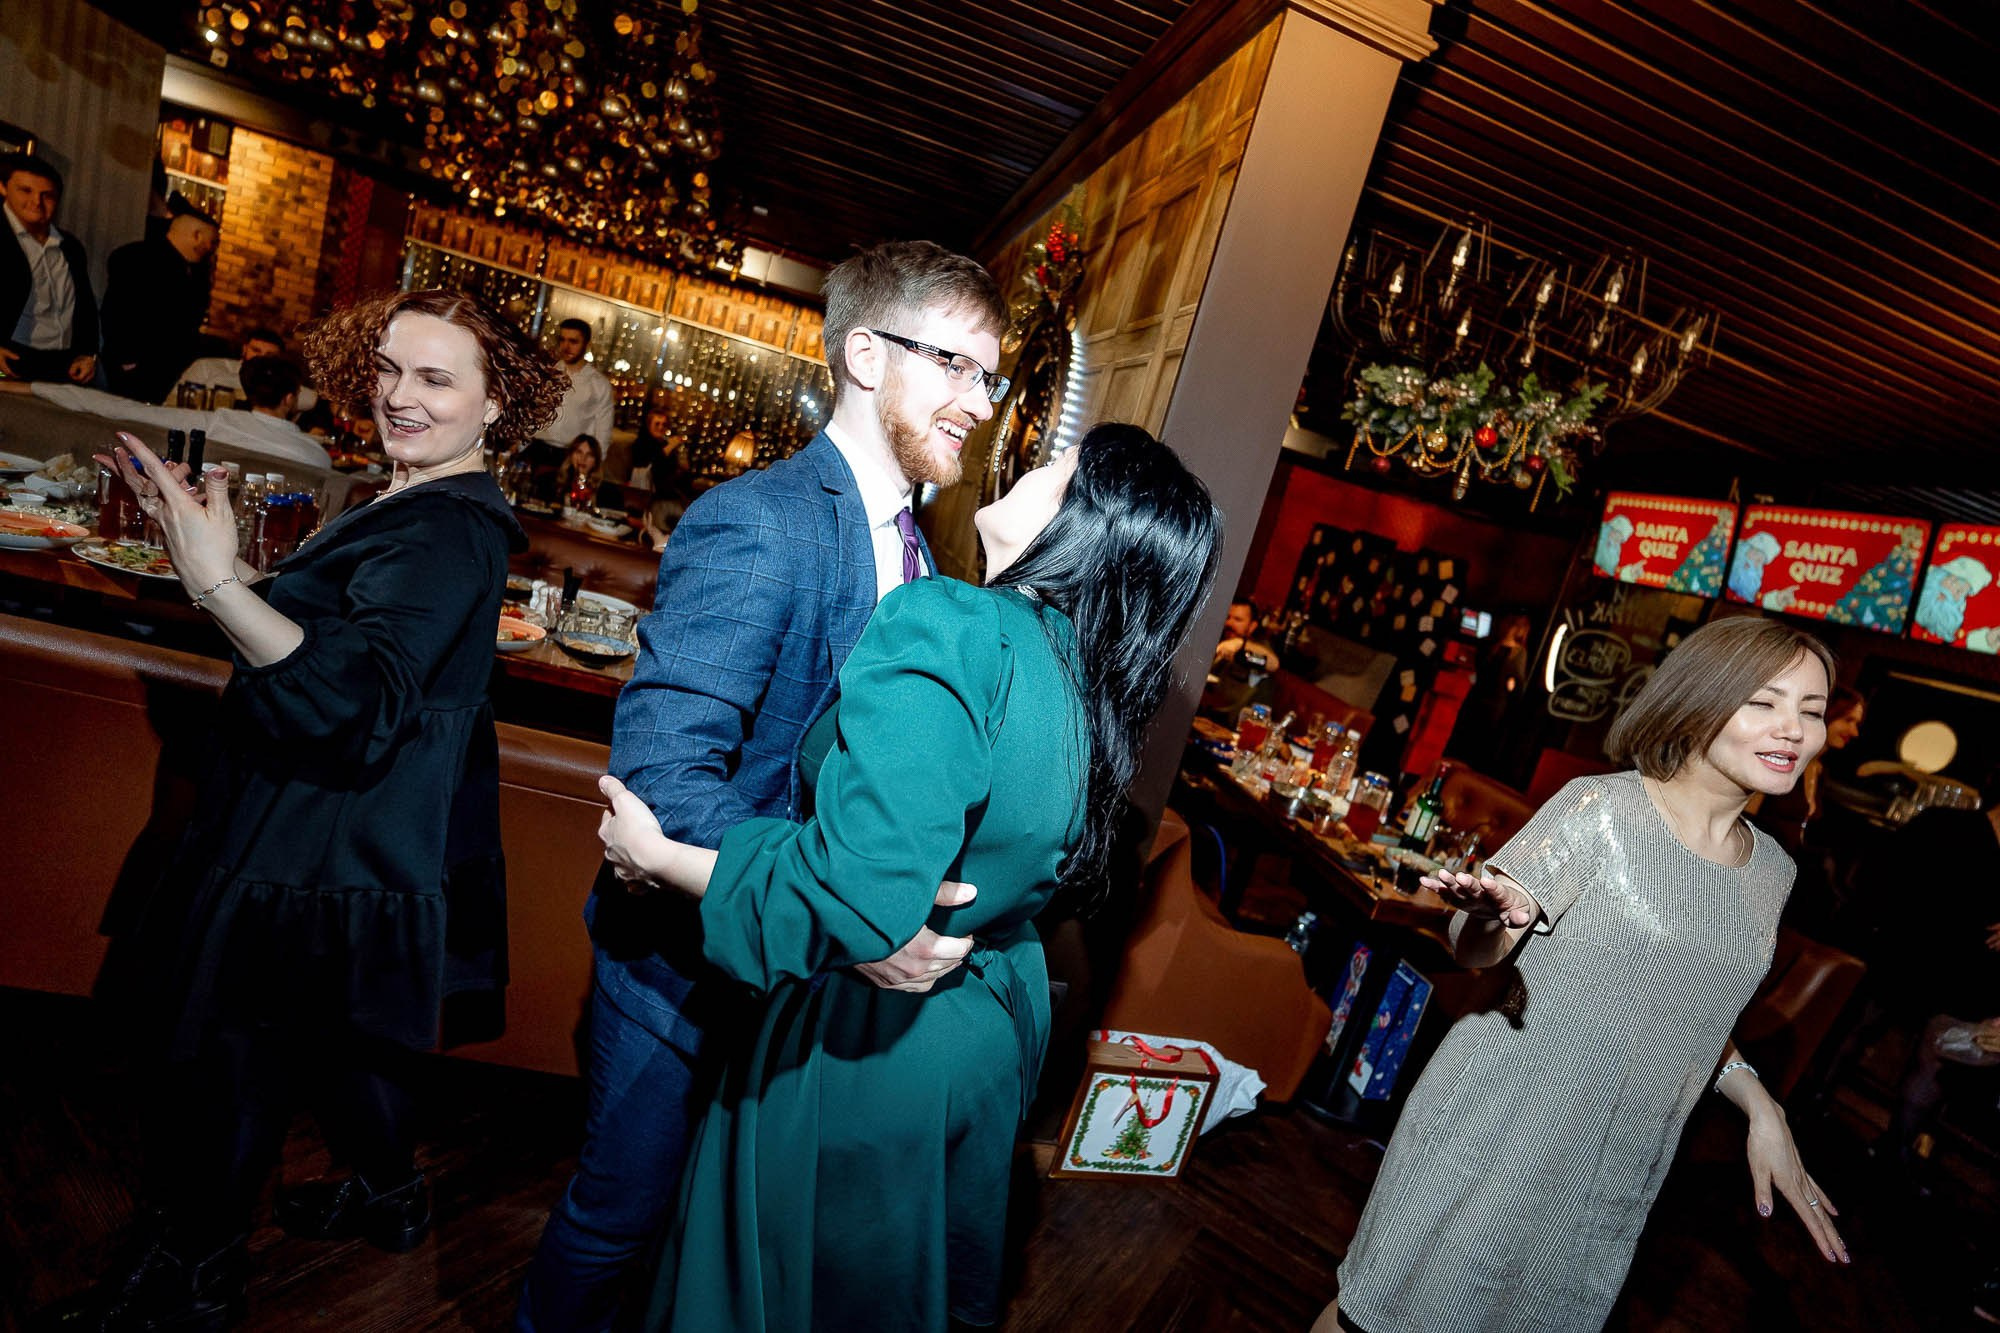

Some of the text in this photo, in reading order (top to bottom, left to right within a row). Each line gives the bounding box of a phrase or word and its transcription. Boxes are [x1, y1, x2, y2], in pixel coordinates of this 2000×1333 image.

[1635, 521, 1689, 544] SANTA
[1639, 540, 1679, 560] QUIZ
[1784, 540, 1858, 567] SANTA
[1789, 561, 1845, 586] QUIZ
